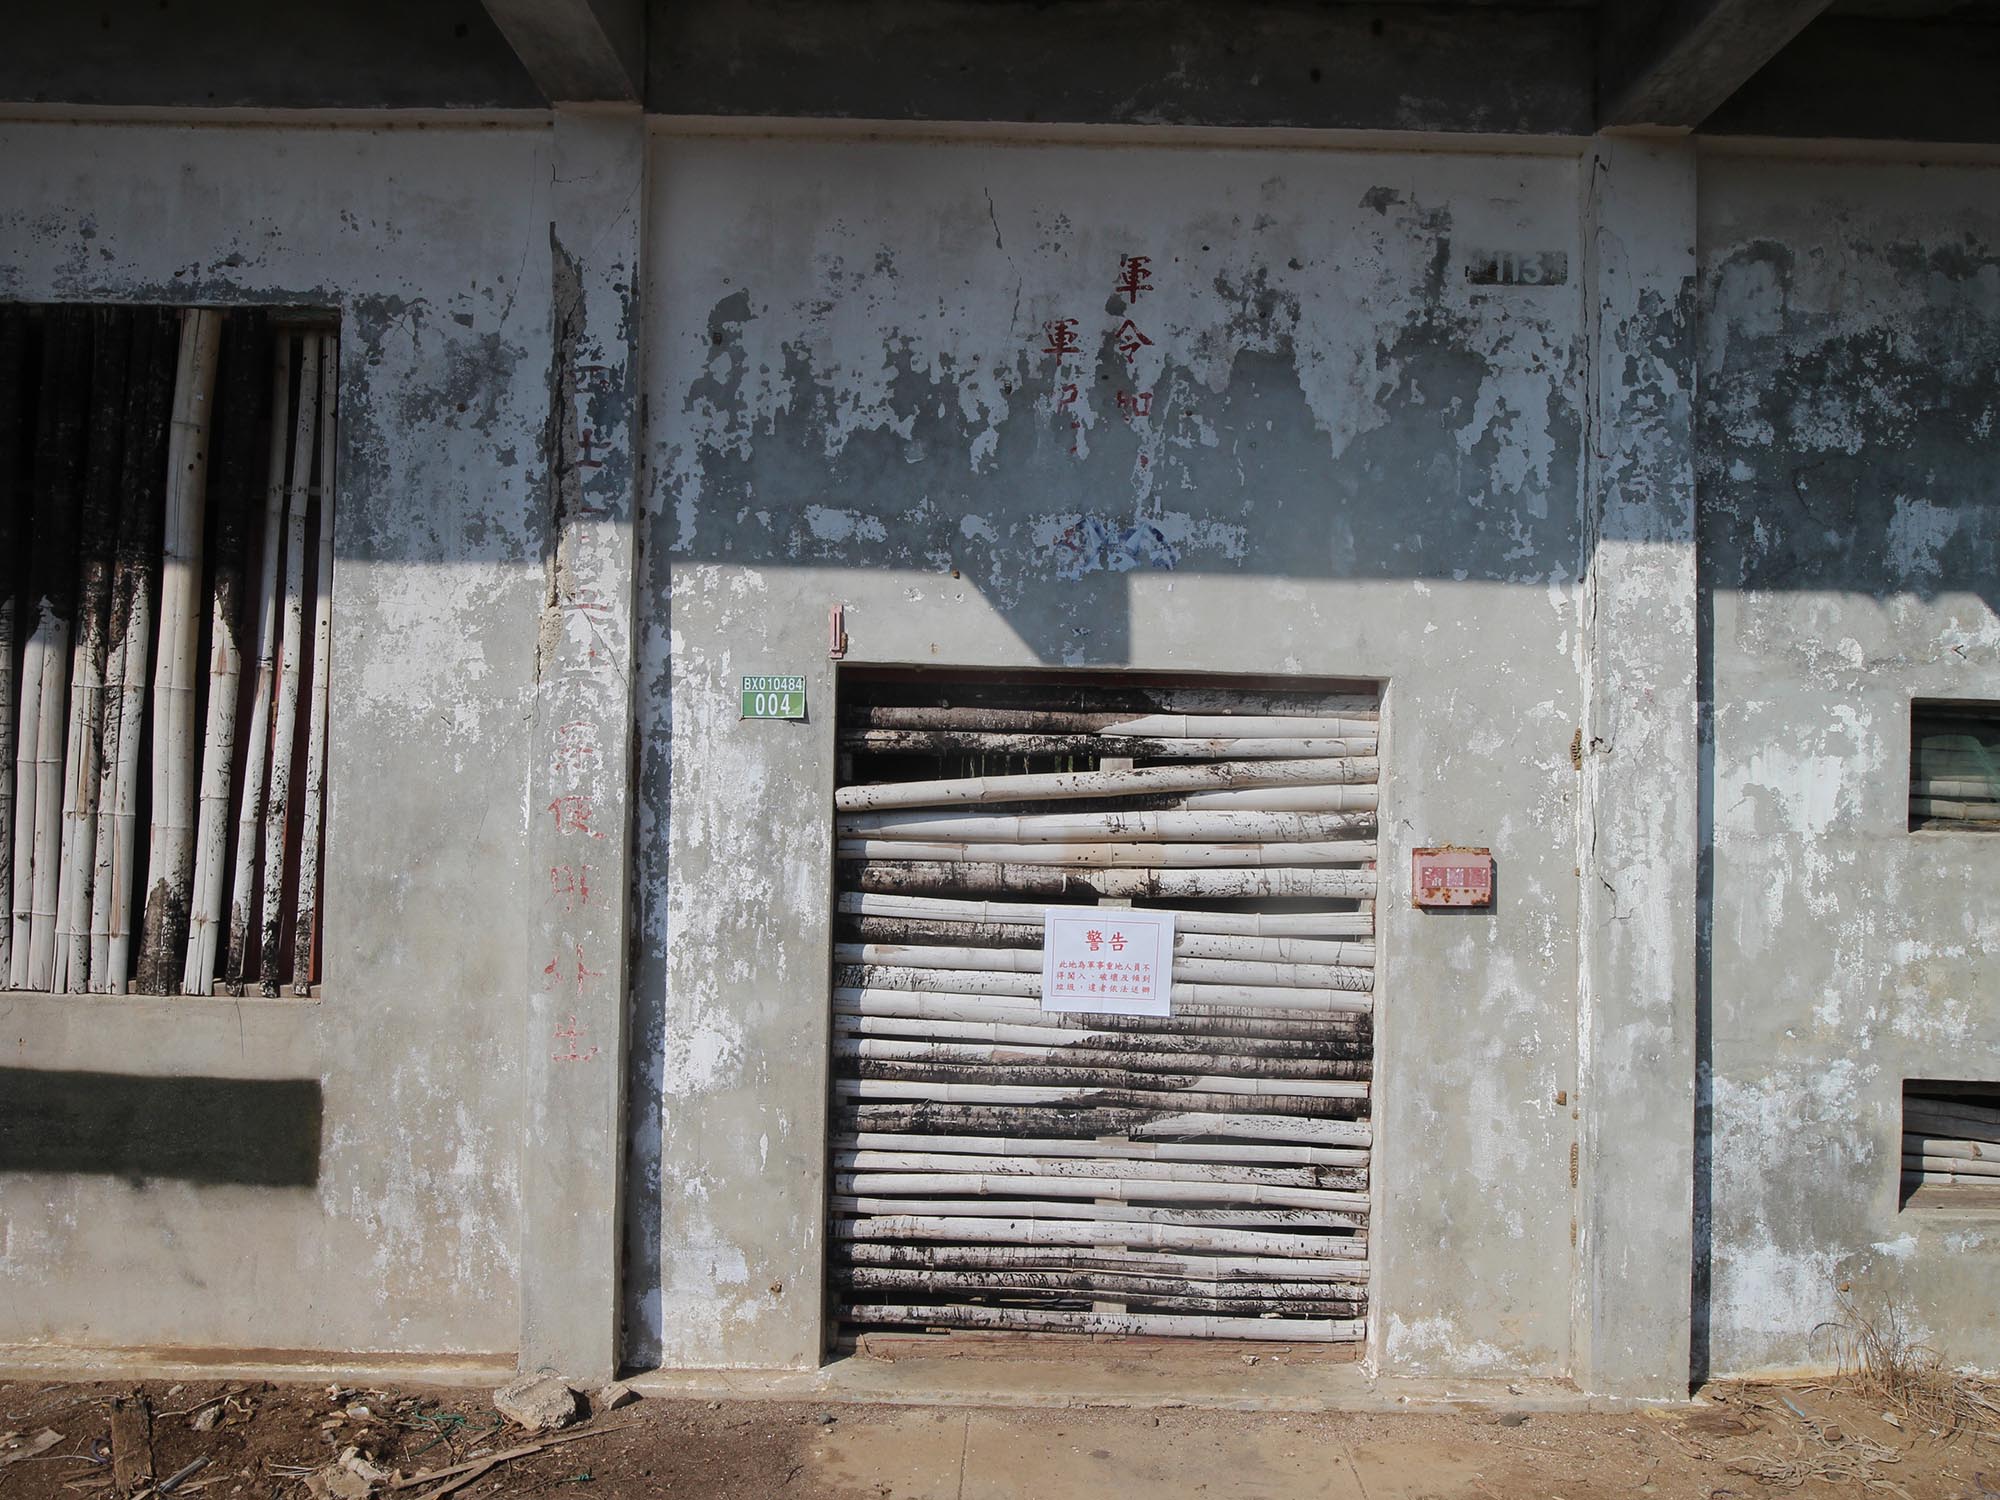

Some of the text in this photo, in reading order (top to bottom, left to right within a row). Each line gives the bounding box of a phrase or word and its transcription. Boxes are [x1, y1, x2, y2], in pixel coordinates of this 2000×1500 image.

[744, 677, 803, 691] BX010484
[755, 693, 791, 715] 004
[1085, 929, 1129, 951] 警告
[1059, 960, 1151, 973] 此地為軍事重地人員不
